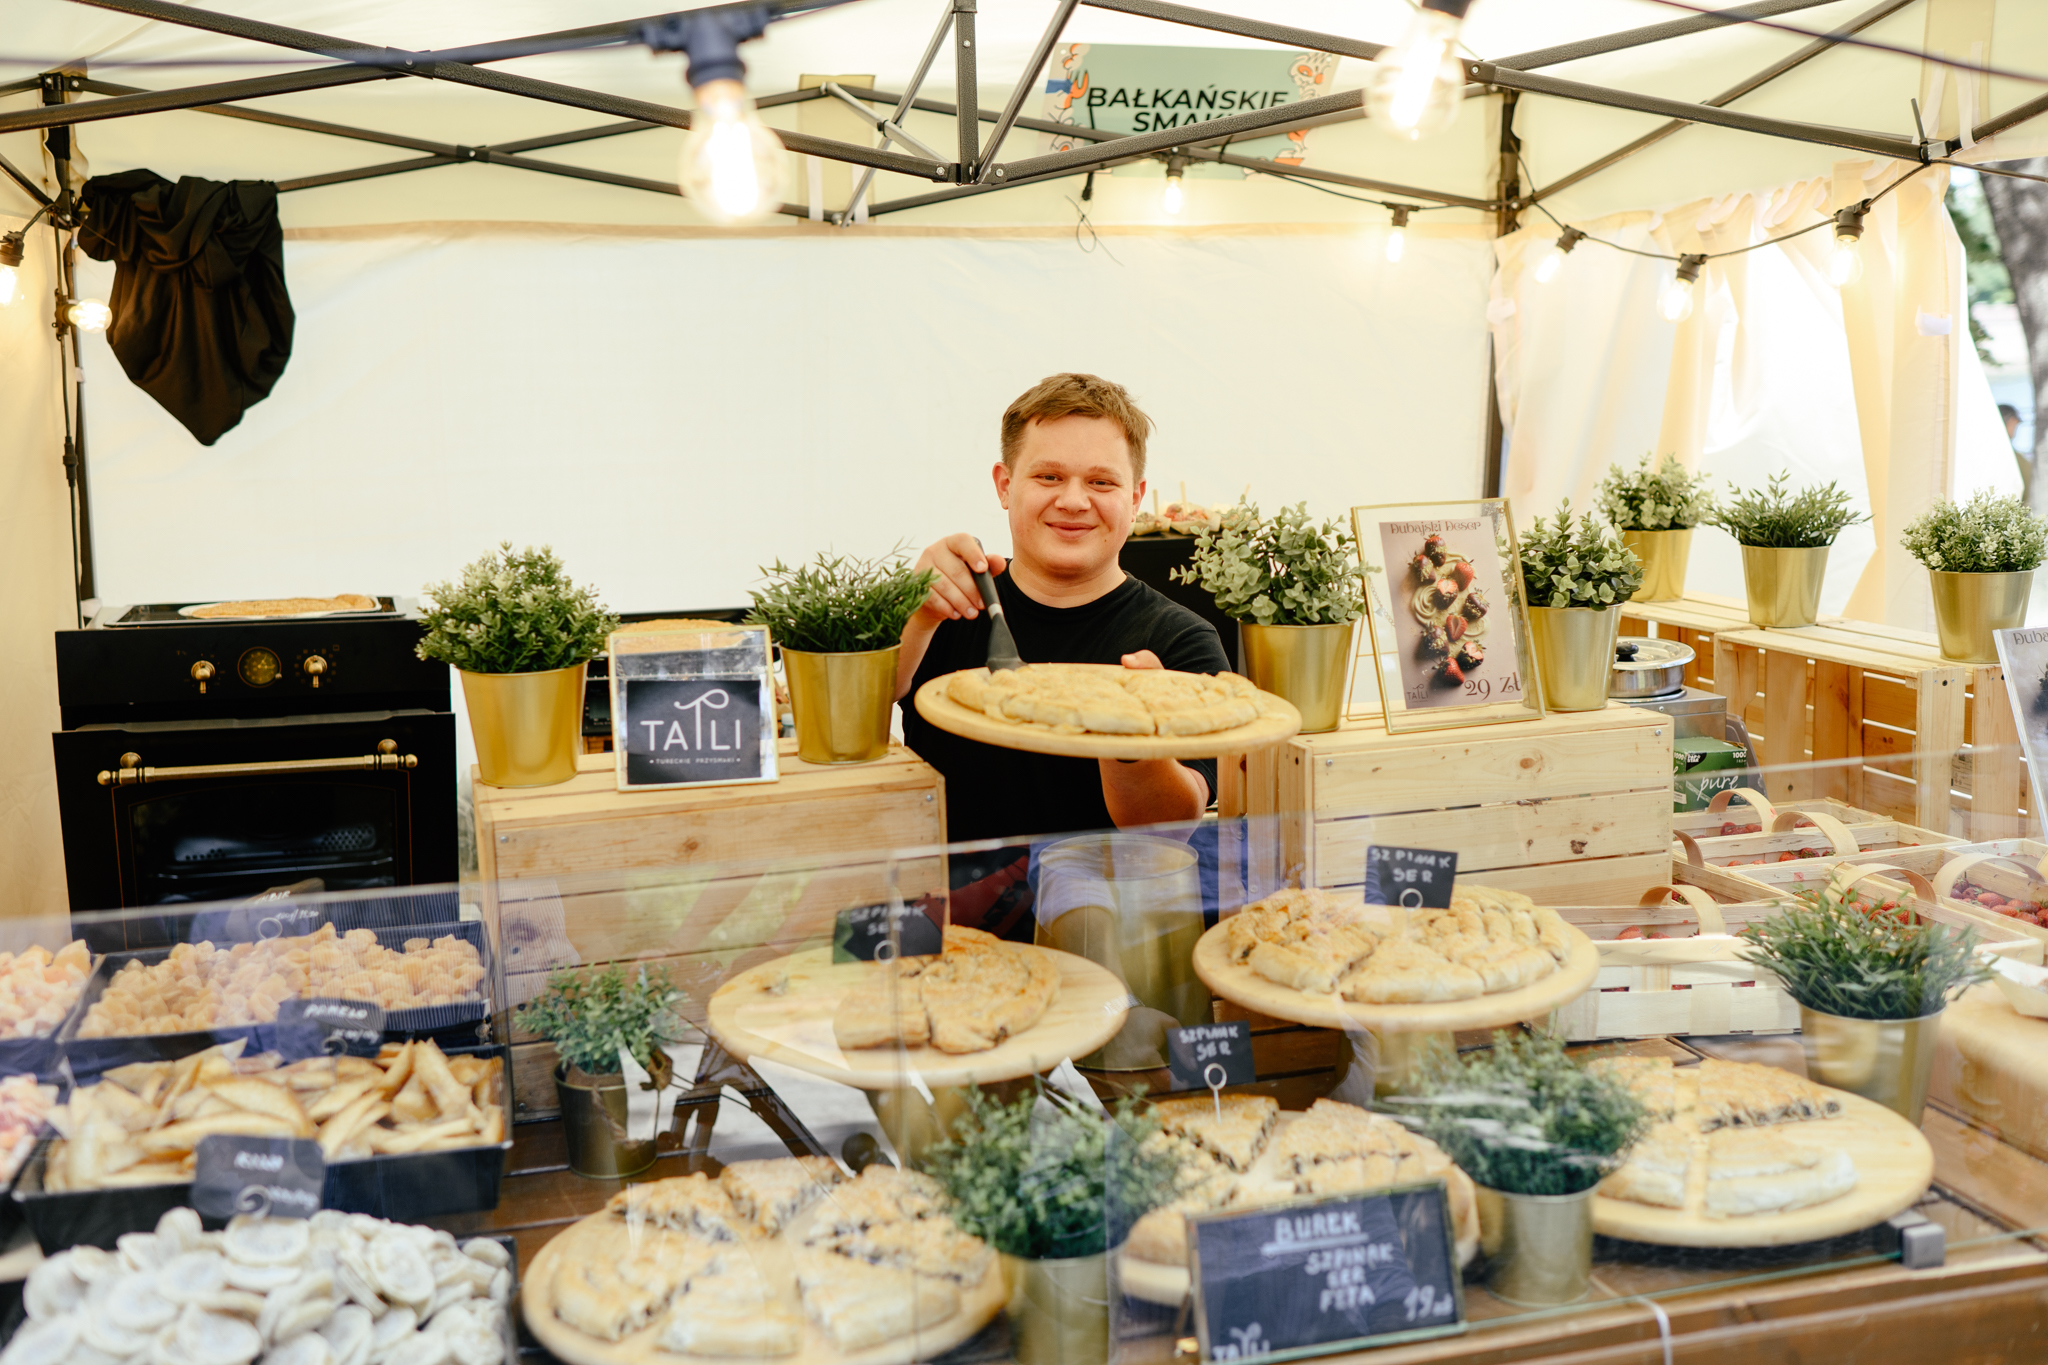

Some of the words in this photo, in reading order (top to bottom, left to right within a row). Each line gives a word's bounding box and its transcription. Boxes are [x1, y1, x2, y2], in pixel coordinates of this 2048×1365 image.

[1086, 84, 1289, 110] BAŁKAŃSKIE
[1390, 521, 1441, 537] Dubajski
[1445, 520, 1481, 532] Deser
[1407, 683, 1429, 700] TATLI
[1464, 678, 1491, 701] 29
[640, 688, 741, 752] TATLI
[1696, 775, 1739, 802] pure
[1370, 848, 1452, 869] SZPINAK
[1393, 867, 1433, 884] SER
[867, 920, 904, 936] SER
[303, 1003, 368, 1020] PAMELO
[1179, 1025, 1239, 1044] SZPINAK
[1196, 1041, 1232, 1062] SER
[1275, 1211, 1361, 1243] BUREK
[1320, 1284, 1376, 1313] FETA
